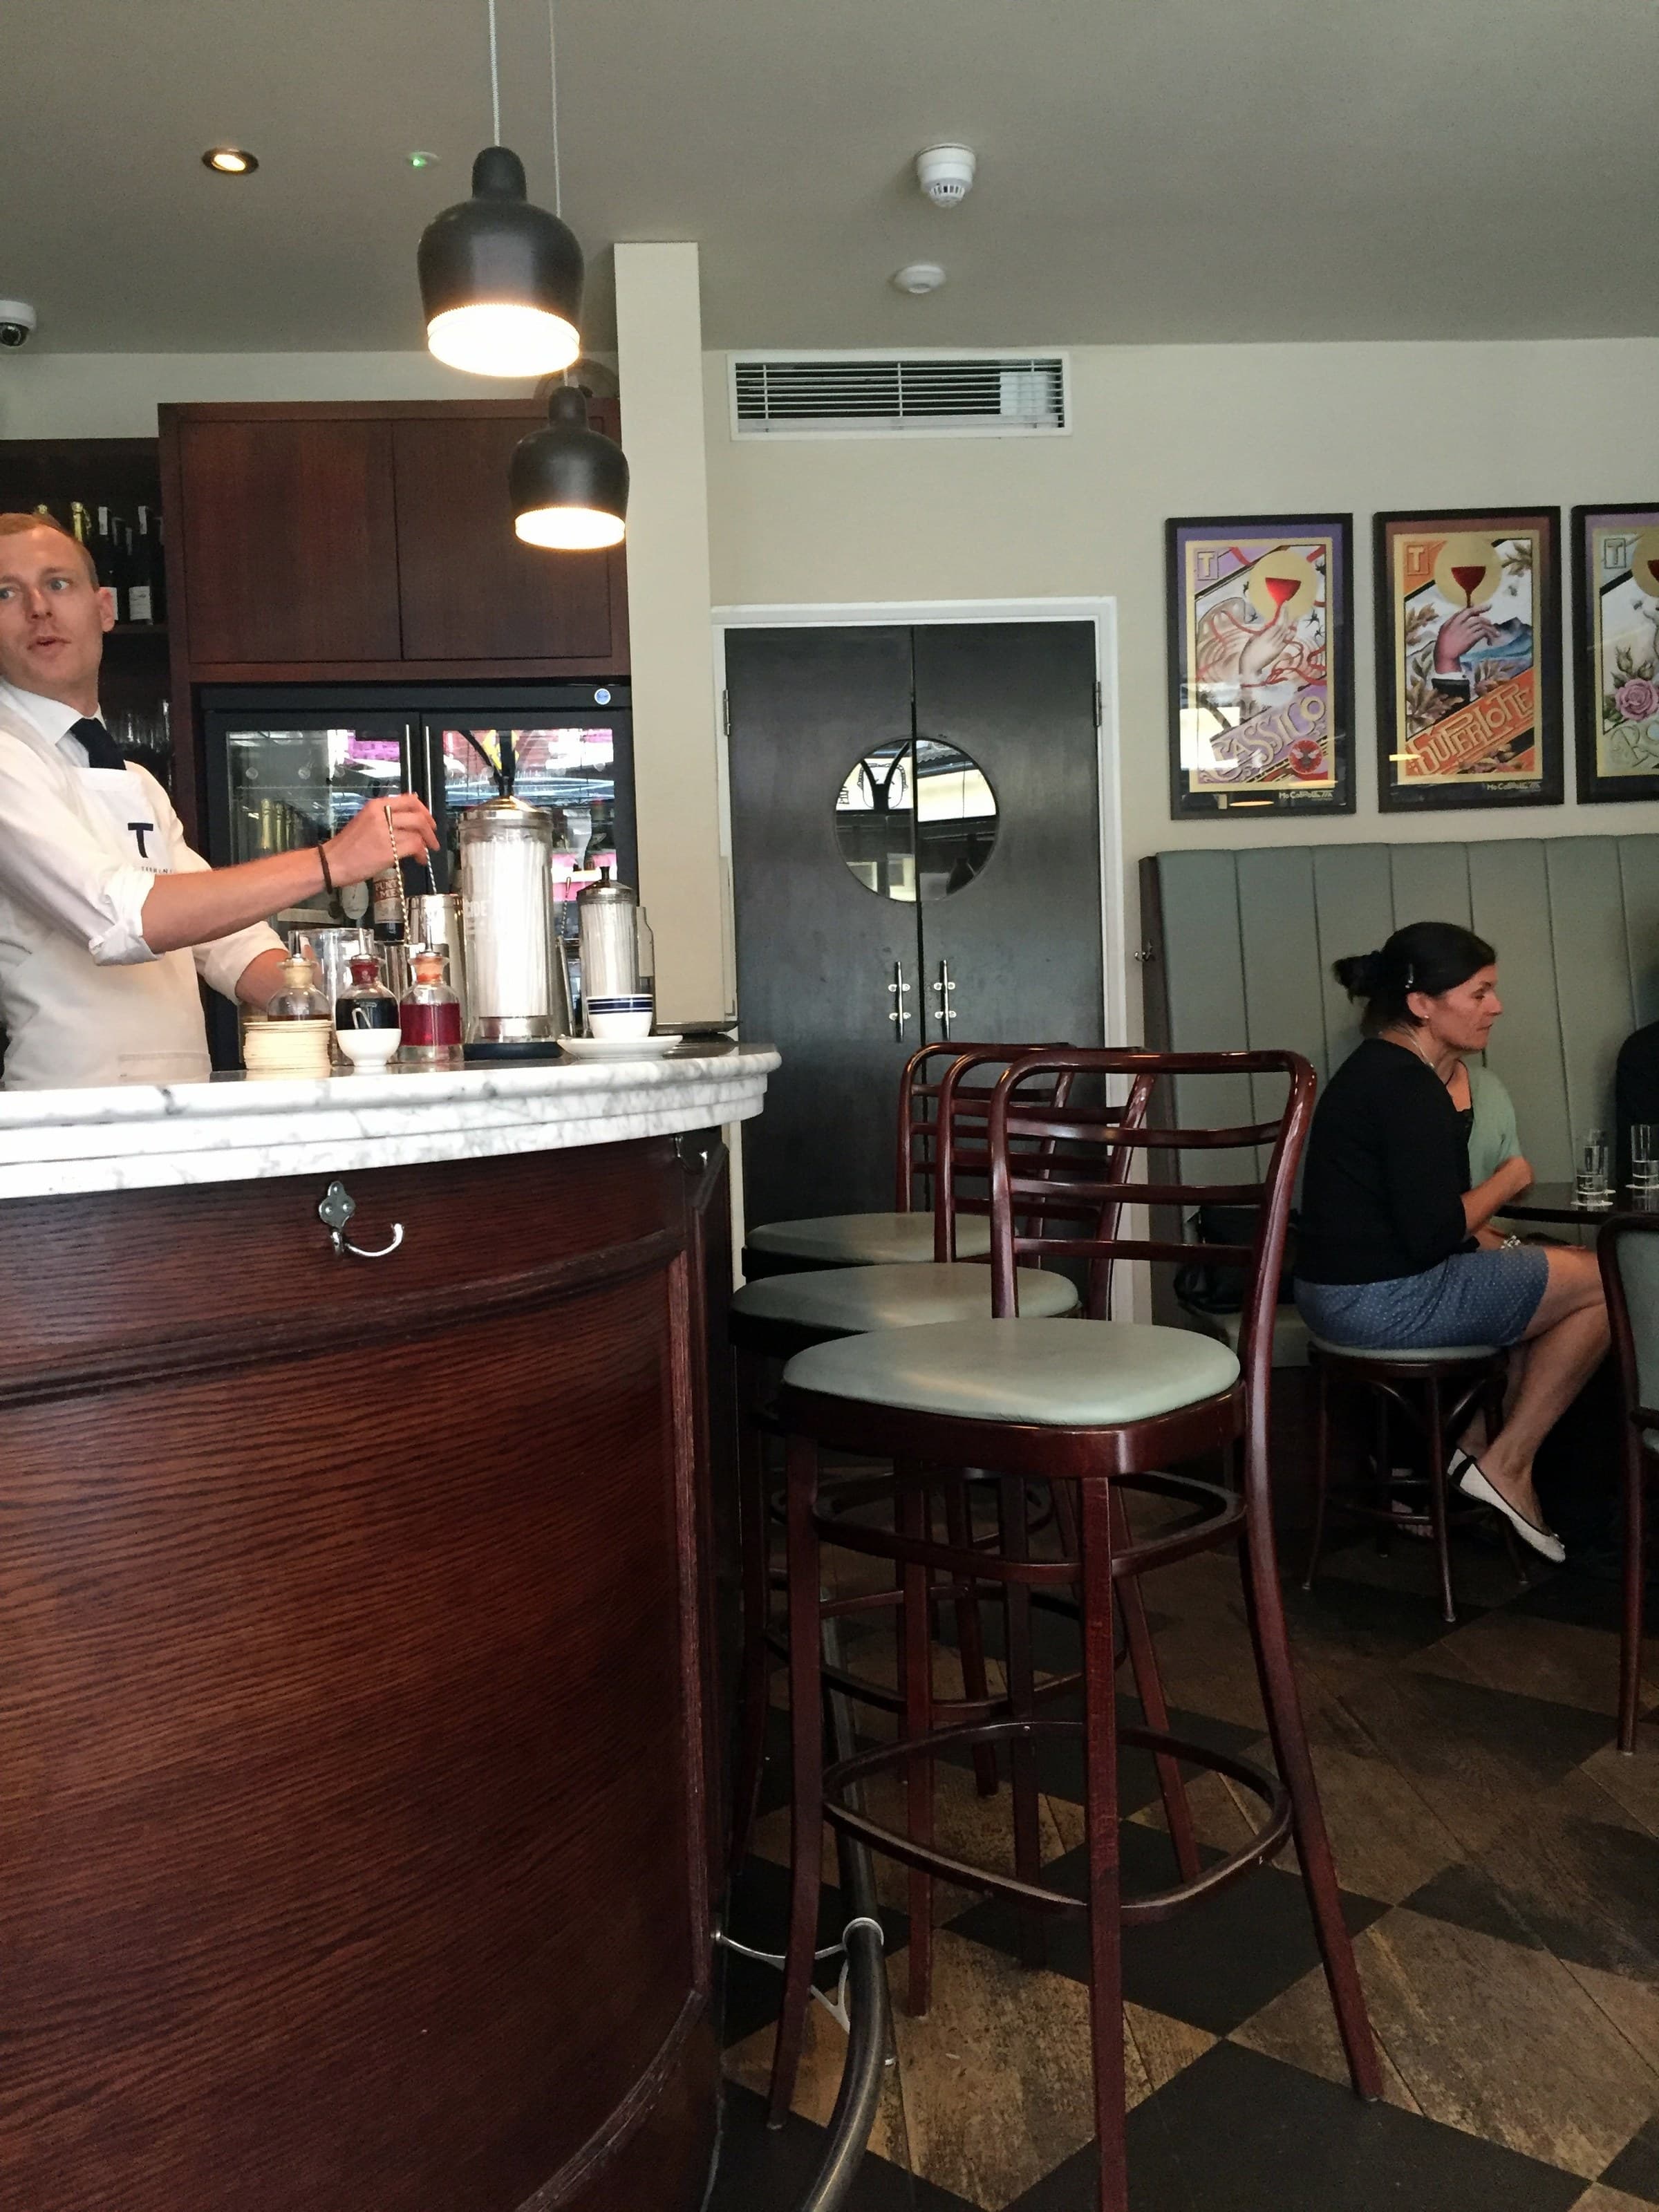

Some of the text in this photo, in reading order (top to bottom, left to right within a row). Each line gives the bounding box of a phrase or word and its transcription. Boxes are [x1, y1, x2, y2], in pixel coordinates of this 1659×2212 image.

[1197, 552, 1215, 577] T
[1407, 545, 1425, 572] T
[1607, 541, 1624, 565] T
[127, 823, 153, 858] T
